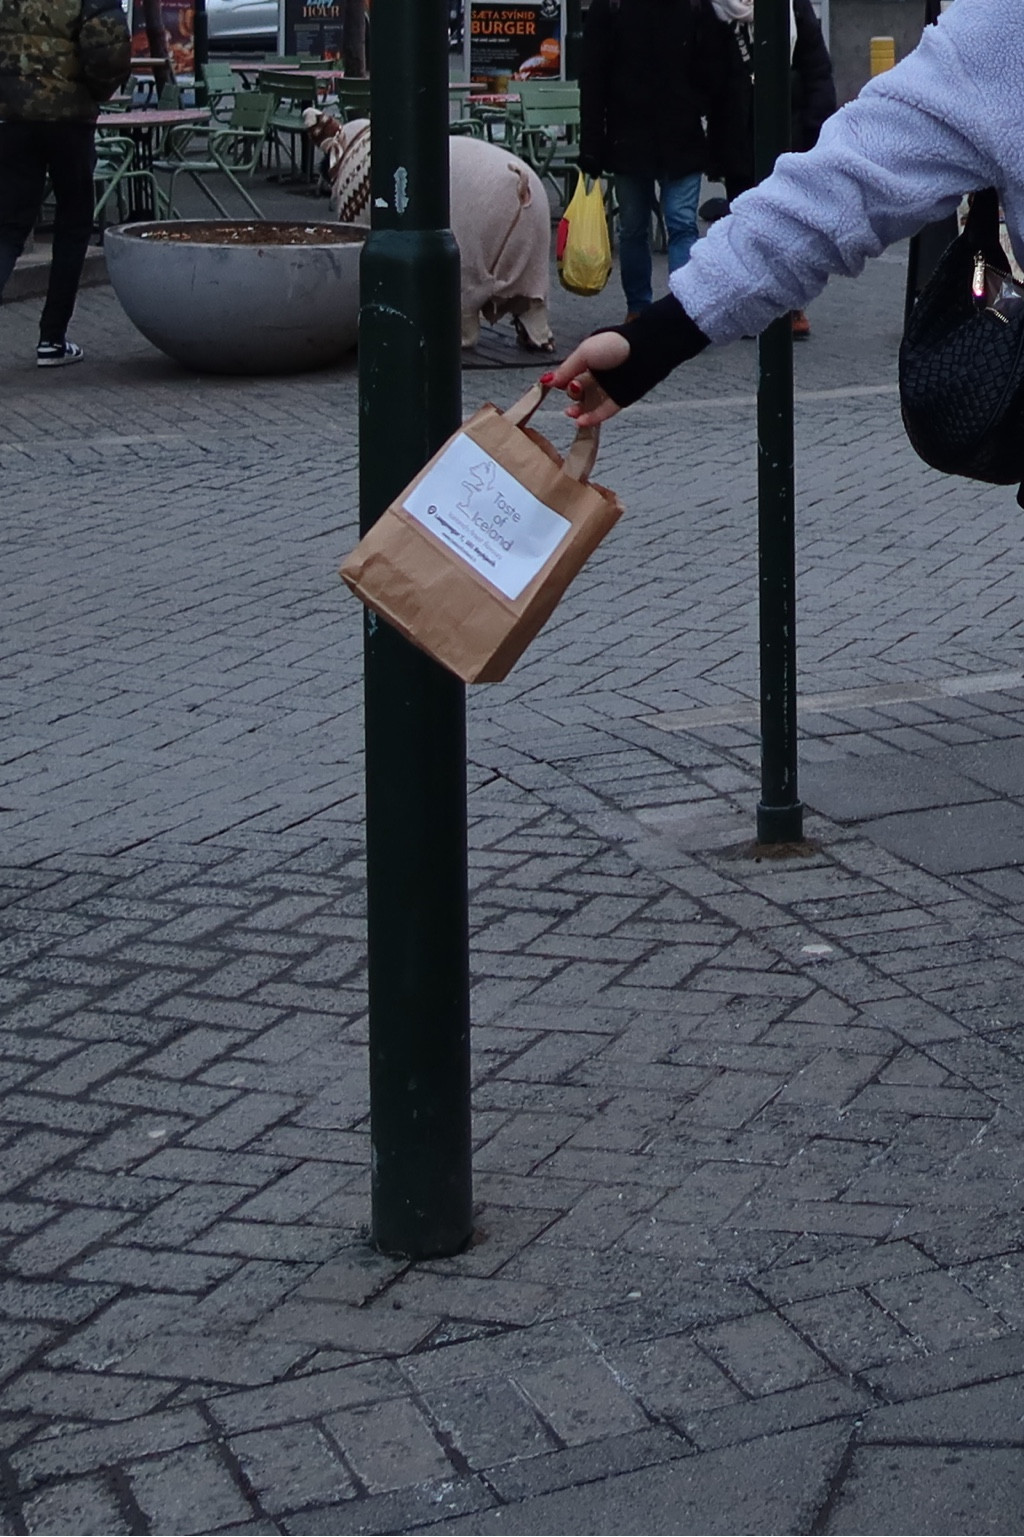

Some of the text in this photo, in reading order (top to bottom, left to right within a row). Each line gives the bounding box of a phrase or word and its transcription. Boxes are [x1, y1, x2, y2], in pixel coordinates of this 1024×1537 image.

[302, 5, 340, 18] HOUR
[471, 20, 536, 36] BURGER
[493, 491, 521, 523] Taste
[493, 514, 508, 528] of
[471, 511, 515, 552] Iceland
